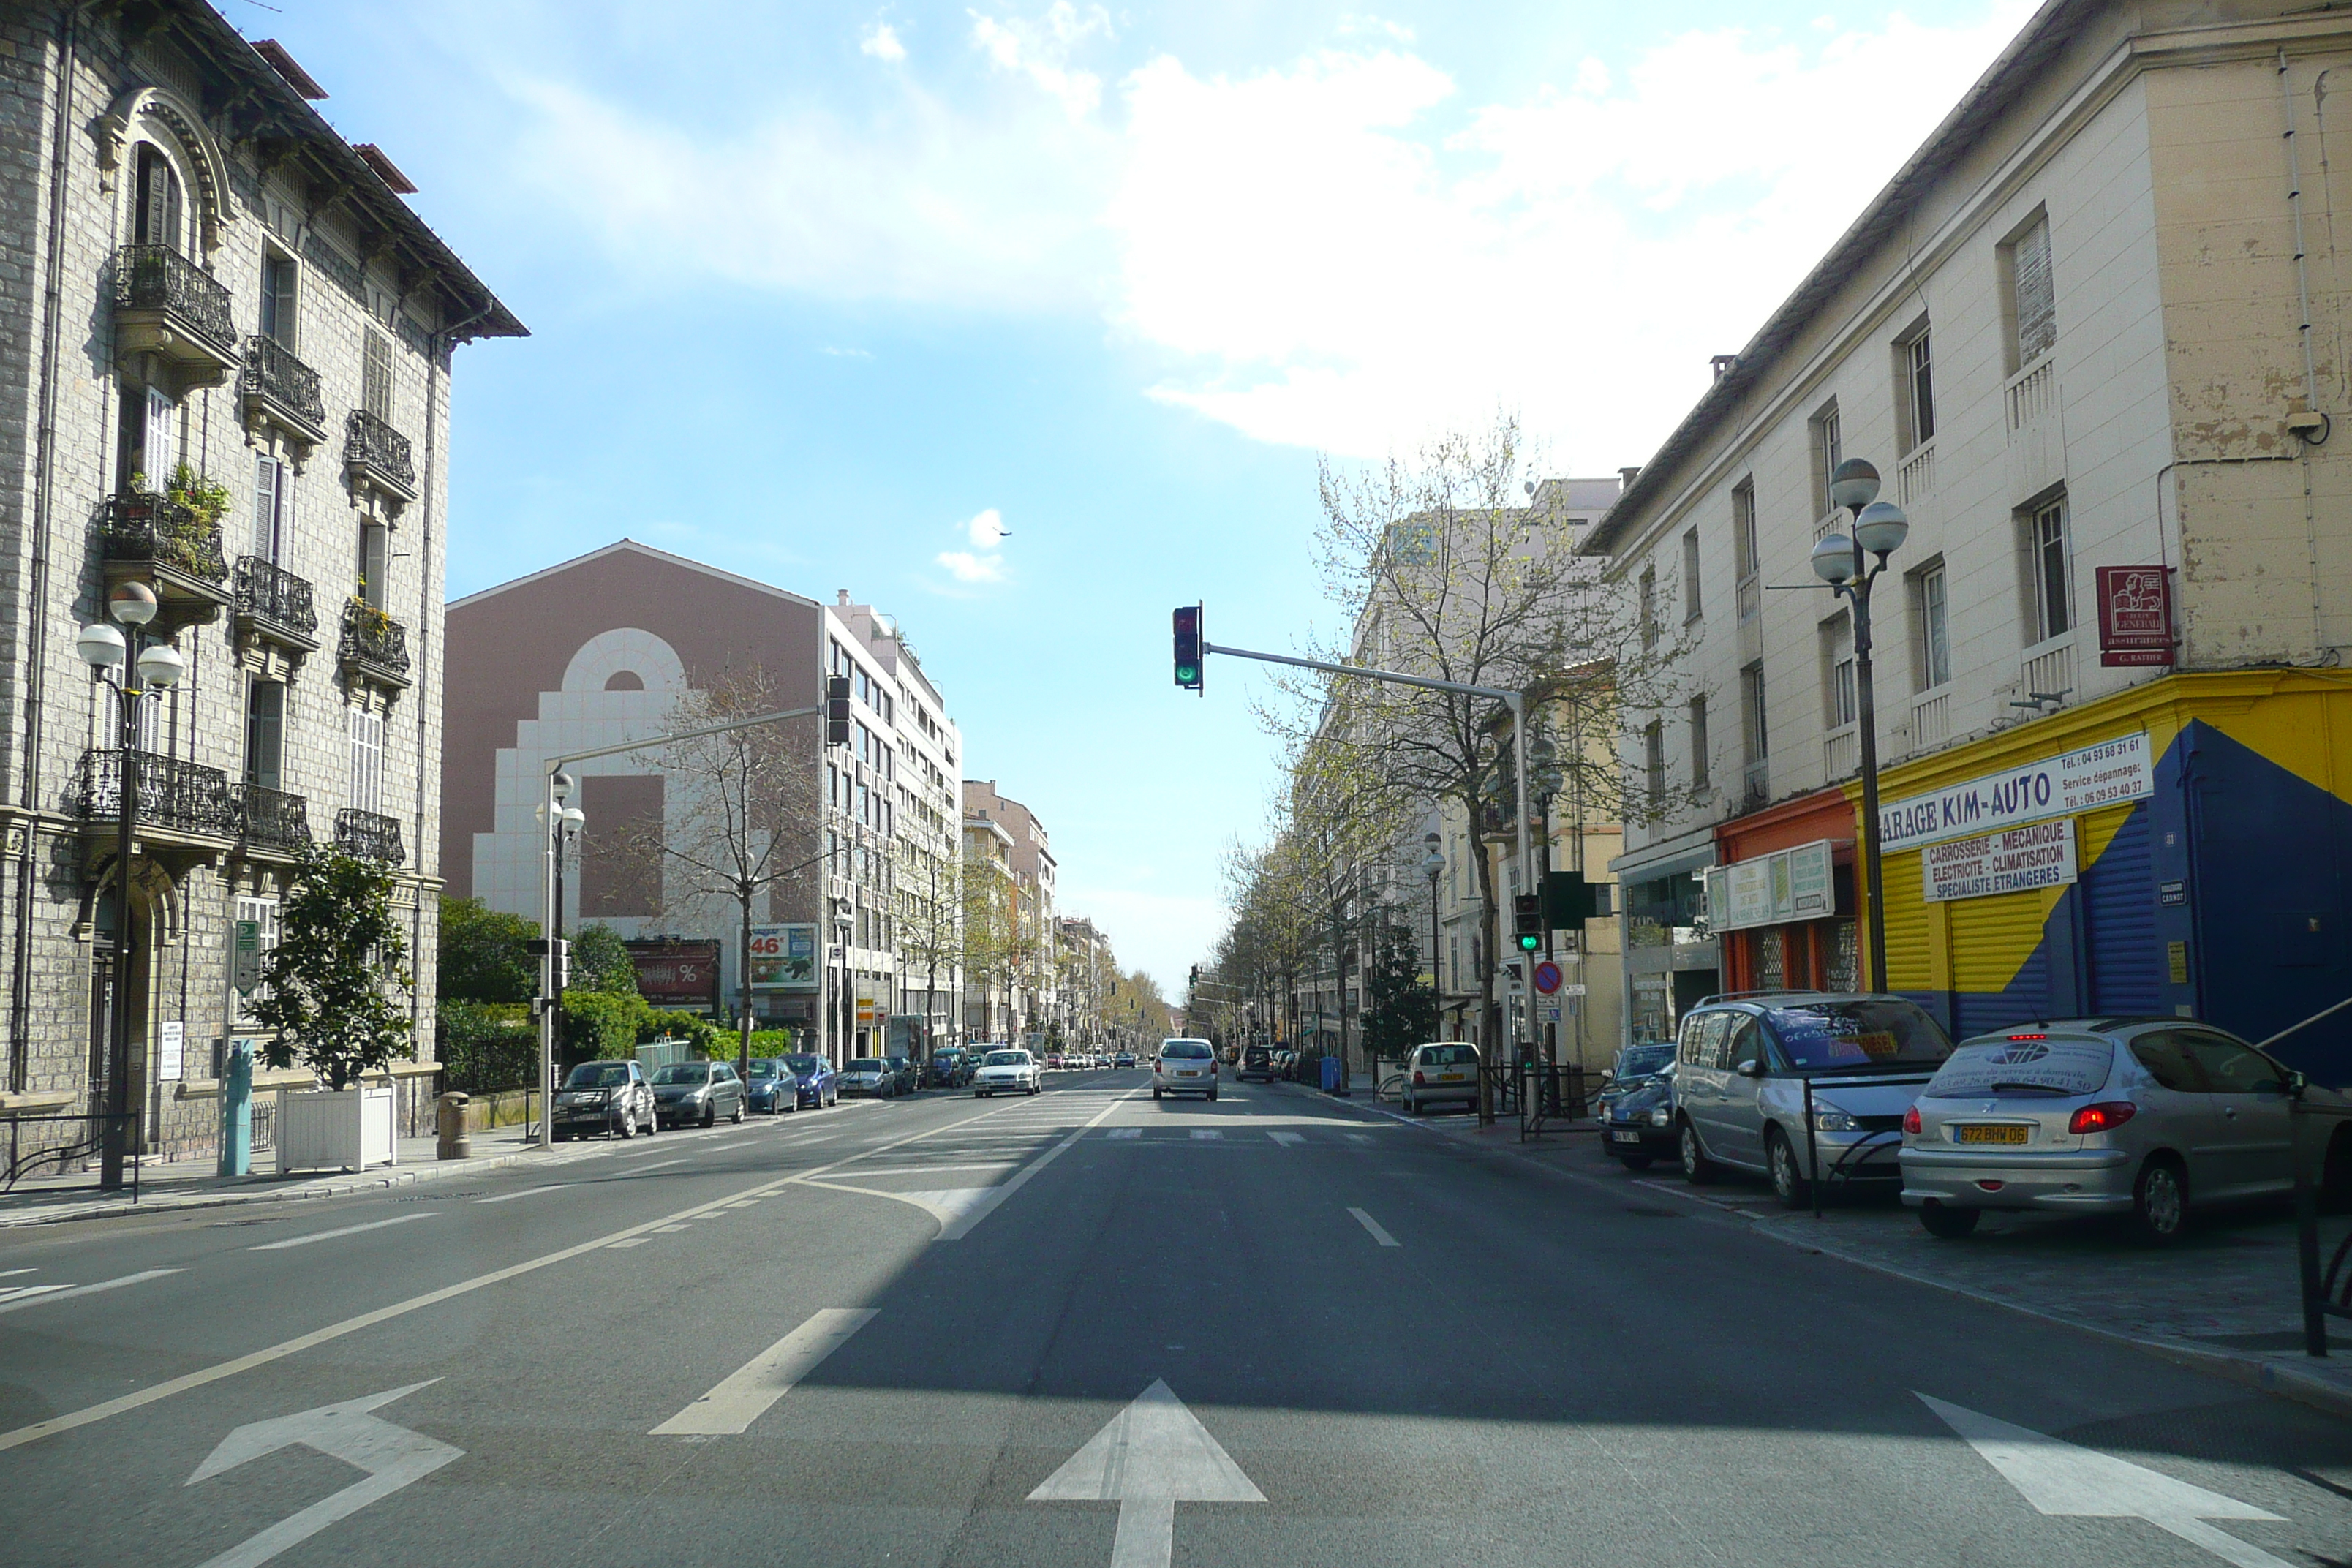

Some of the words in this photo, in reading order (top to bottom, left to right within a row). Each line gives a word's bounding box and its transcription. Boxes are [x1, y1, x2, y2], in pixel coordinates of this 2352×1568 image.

[2117, 620, 2160, 630] GENERALI
[2108, 637, 2170, 646] assurances
[2061, 756, 2076, 770] Tél.
[2081, 753, 2092, 765] 04
[2093, 748, 2103, 761] 93
[2105, 745, 2115, 758] 68
[2117, 742, 2127, 755] 31
[2129, 738, 2140, 752] 61
[2062, 775, 2092, 790] Service
[2064, 795, 2078, 808] Tél.
[2084, 792, 2095, 804] 06
[2096, 788, 2106, 801] 09
[2108, 785, 2118, 799] 53
[2119, 783, 2130, 796] 40
[2131, 780, 2142, 794] 37
[1879, 802, 1937, 843] ARAGE
[1942, 772, 2051, 828] KIM-AUTO
[1929, 837, 1991, 864] CARROSSERIE
[2002, 822, 2064, 851] MECANIQUE
[1932, 859, 1983, 883] ELECTRICITE
[1992, 844, 2064, 872] CLIMATISATION
[1937, 877, 1991, 899] SPECIALISTE
[1994, 865, 2059, 890] ETRANGERES
[1961, 1128, 1982, 1141] 672
[1984, 1128, 2006, 1141] BHW
[2010, 1128, 2025, 1141] 06
